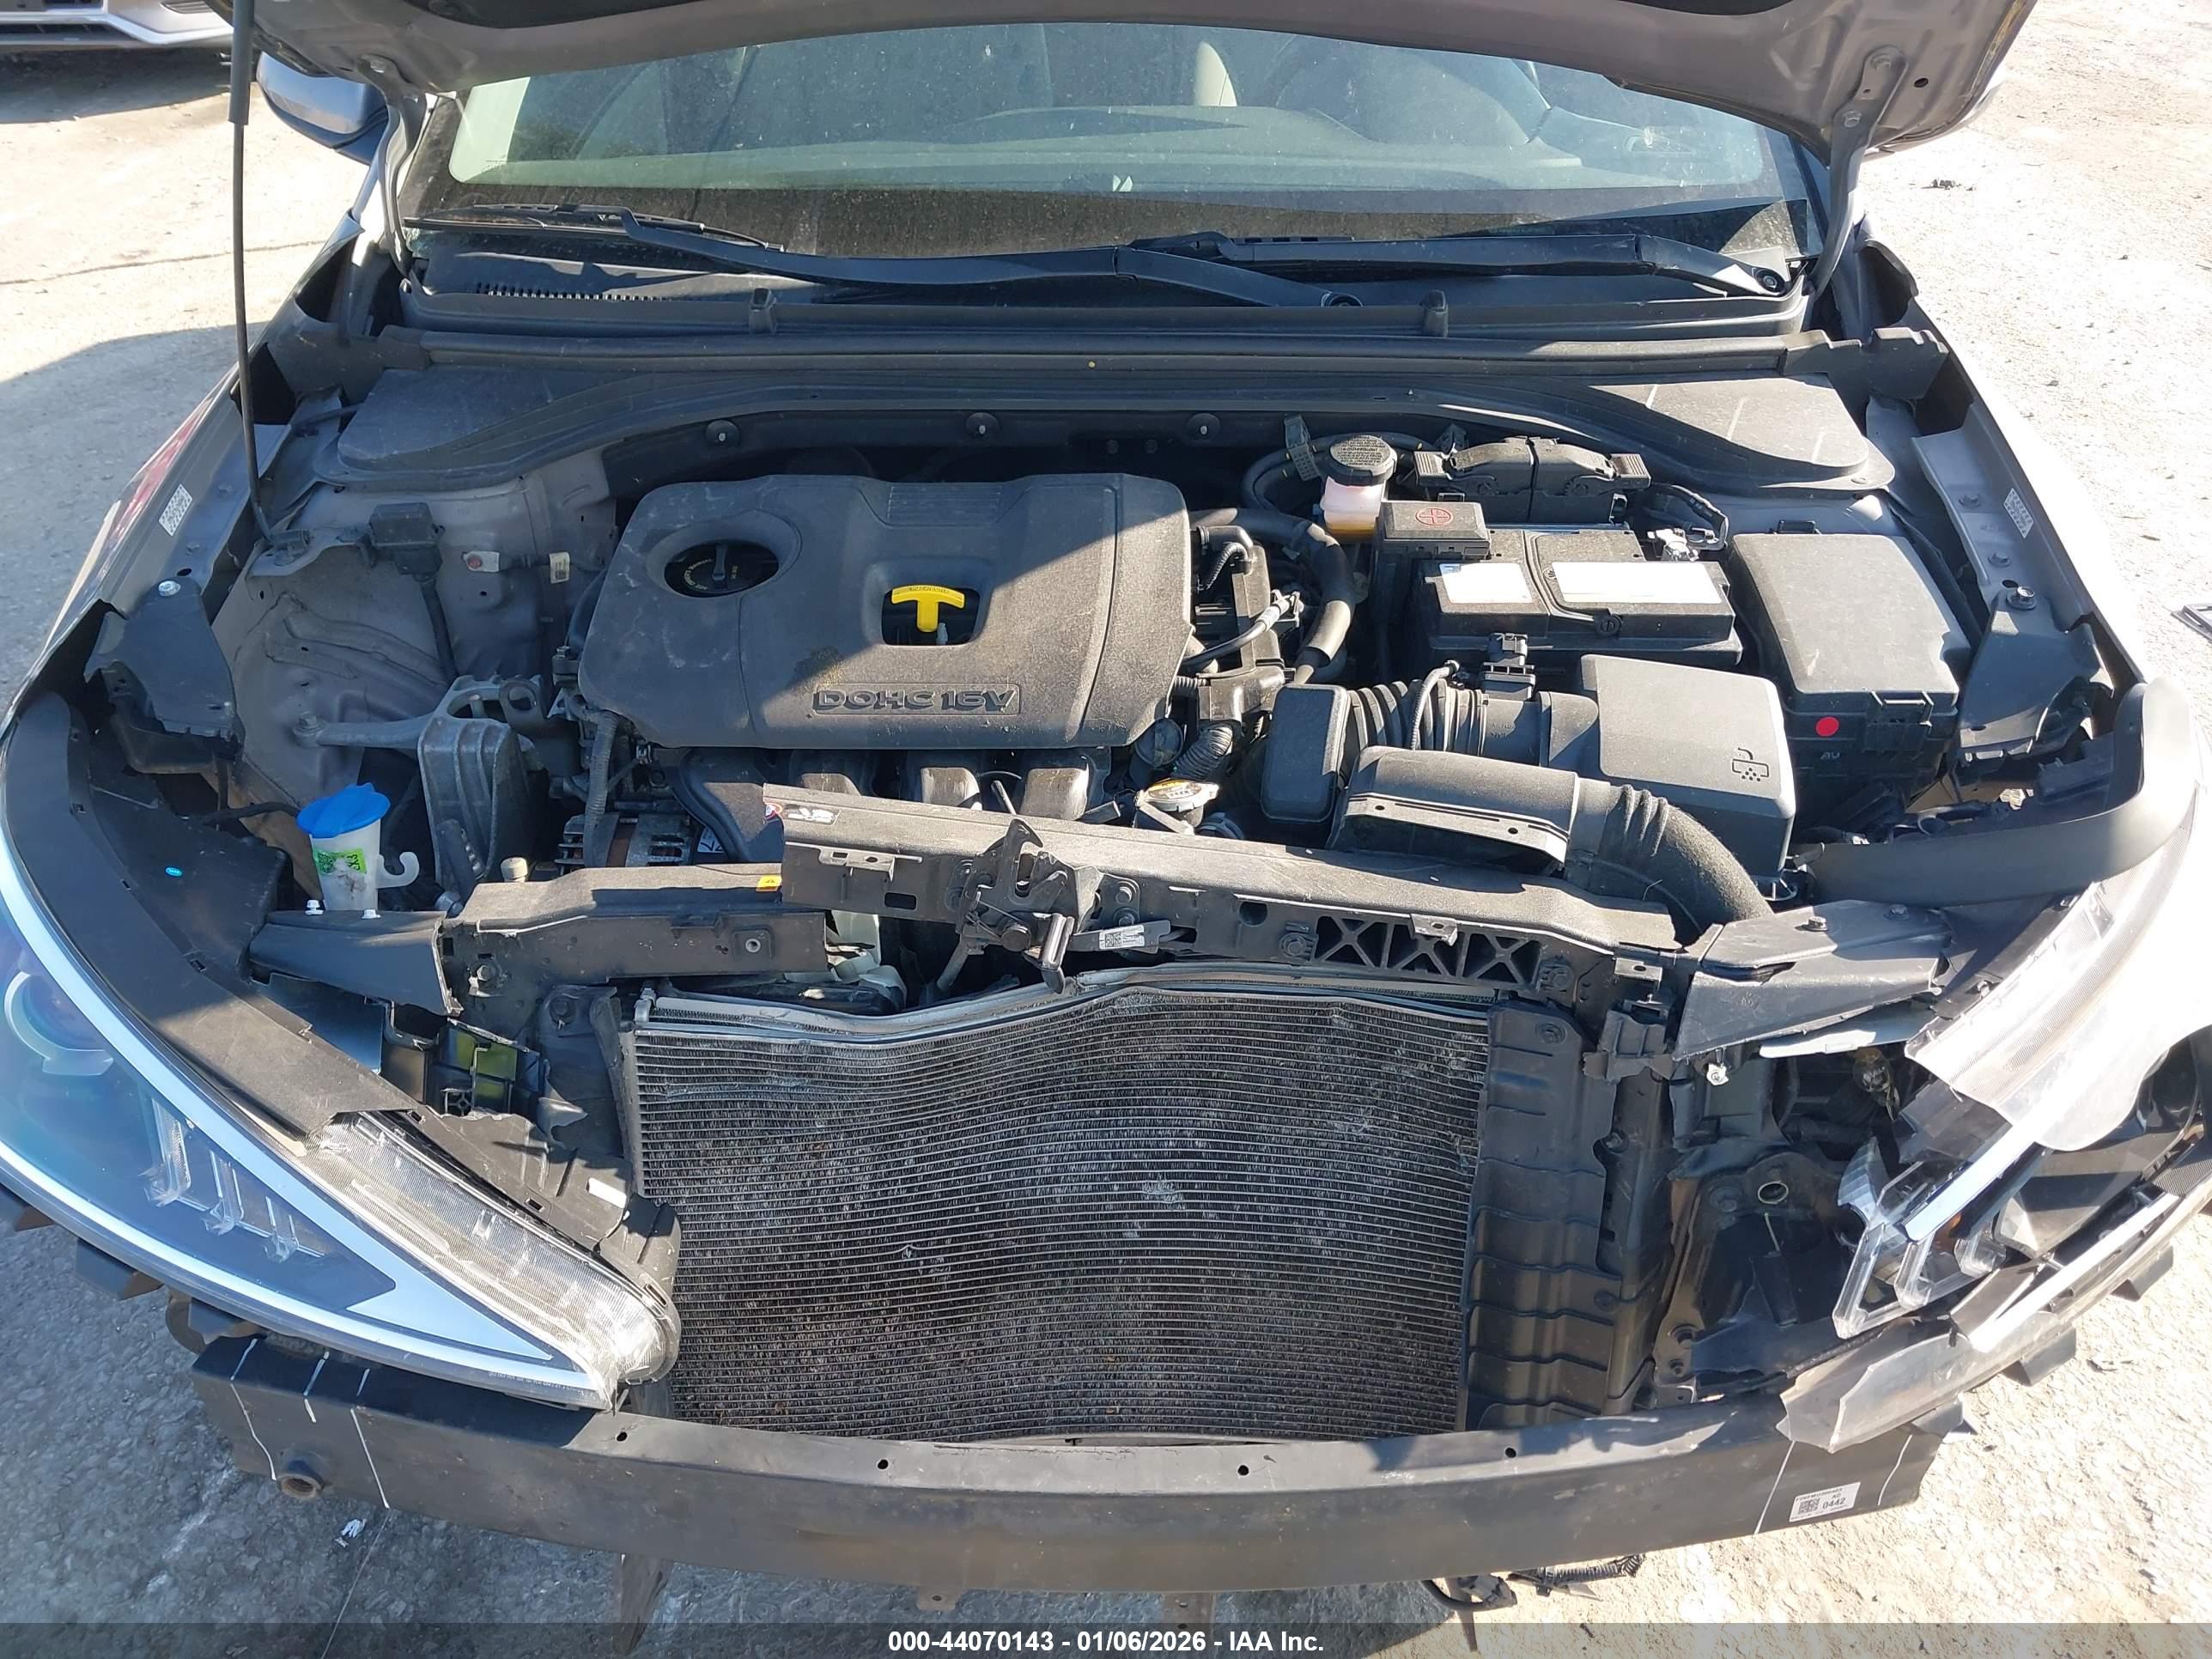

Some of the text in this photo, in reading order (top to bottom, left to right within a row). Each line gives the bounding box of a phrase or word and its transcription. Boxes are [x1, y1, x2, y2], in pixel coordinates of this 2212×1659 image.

[817, 690, 1016, 709] DOHC 16V
[1822, 1497, 1847, 1510] 0442
